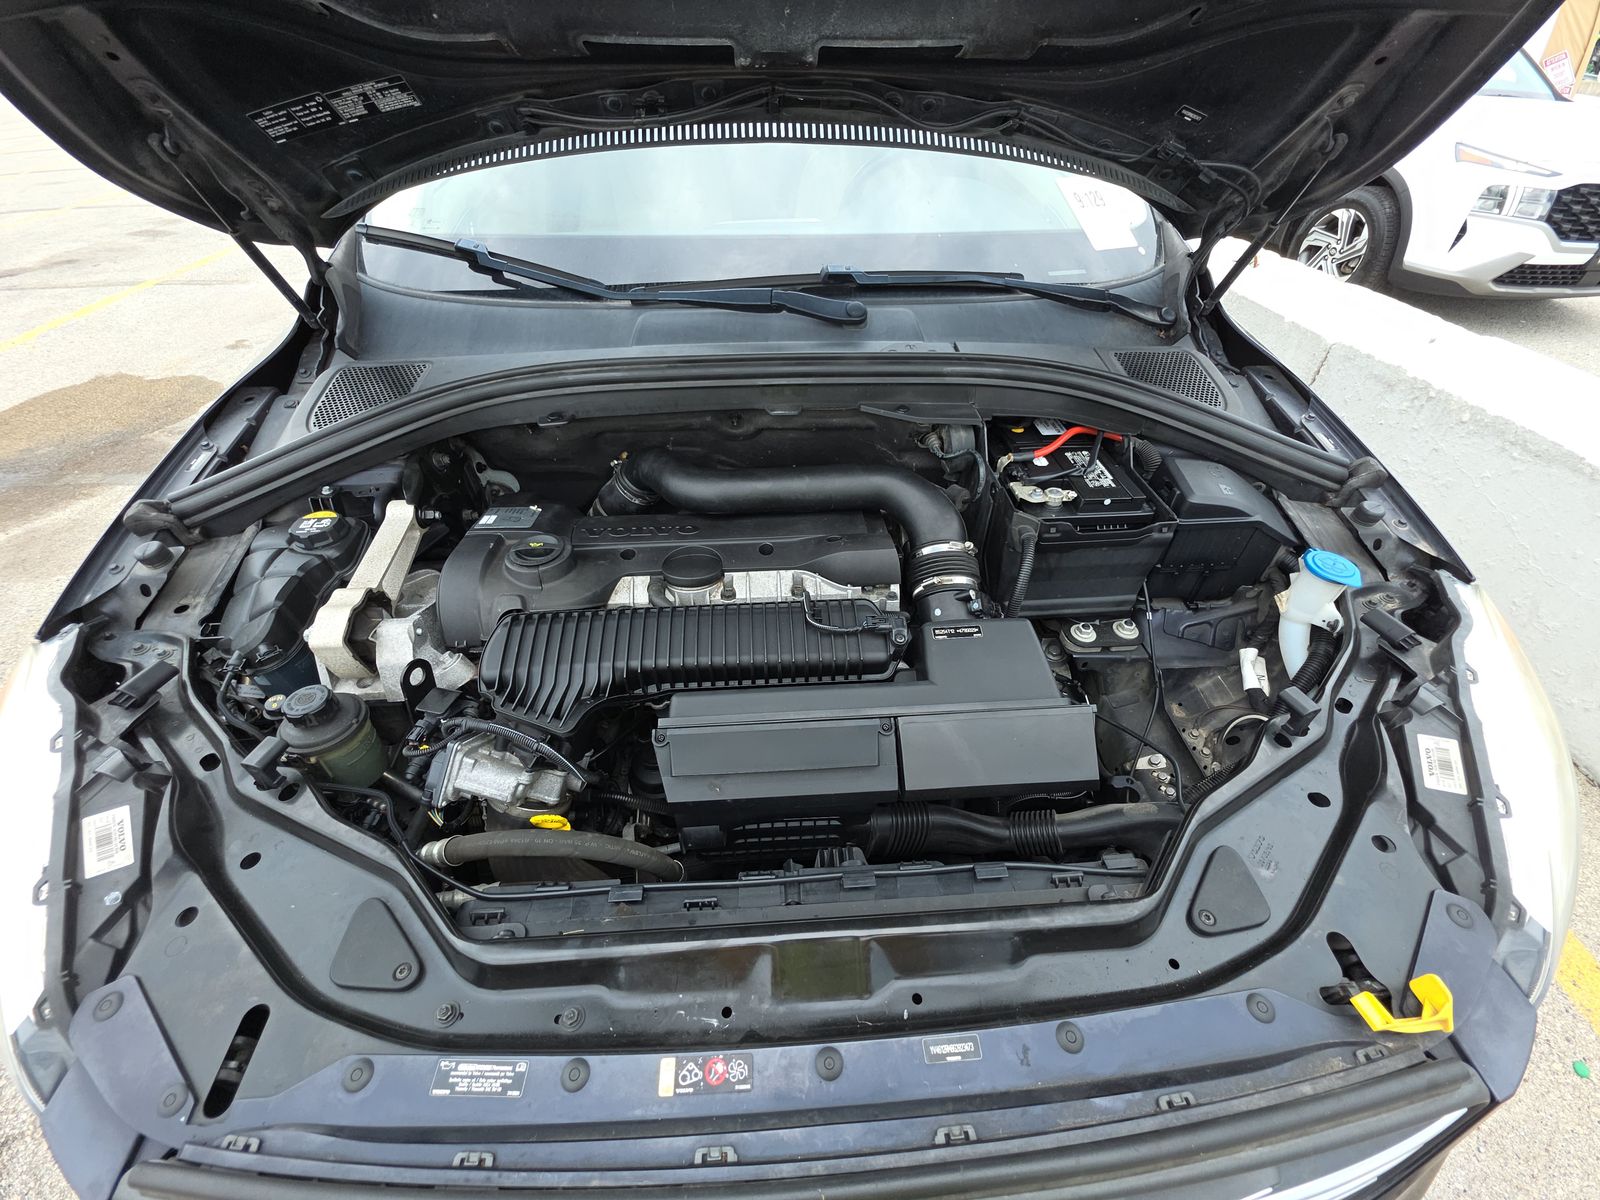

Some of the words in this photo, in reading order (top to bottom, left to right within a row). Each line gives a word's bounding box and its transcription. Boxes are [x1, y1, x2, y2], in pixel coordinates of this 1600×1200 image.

[581, 524, 700, 538] VOLVO
[1425, 747, 1435, 777] VOLVO
[117, 818, 127, 852] VOLVO
